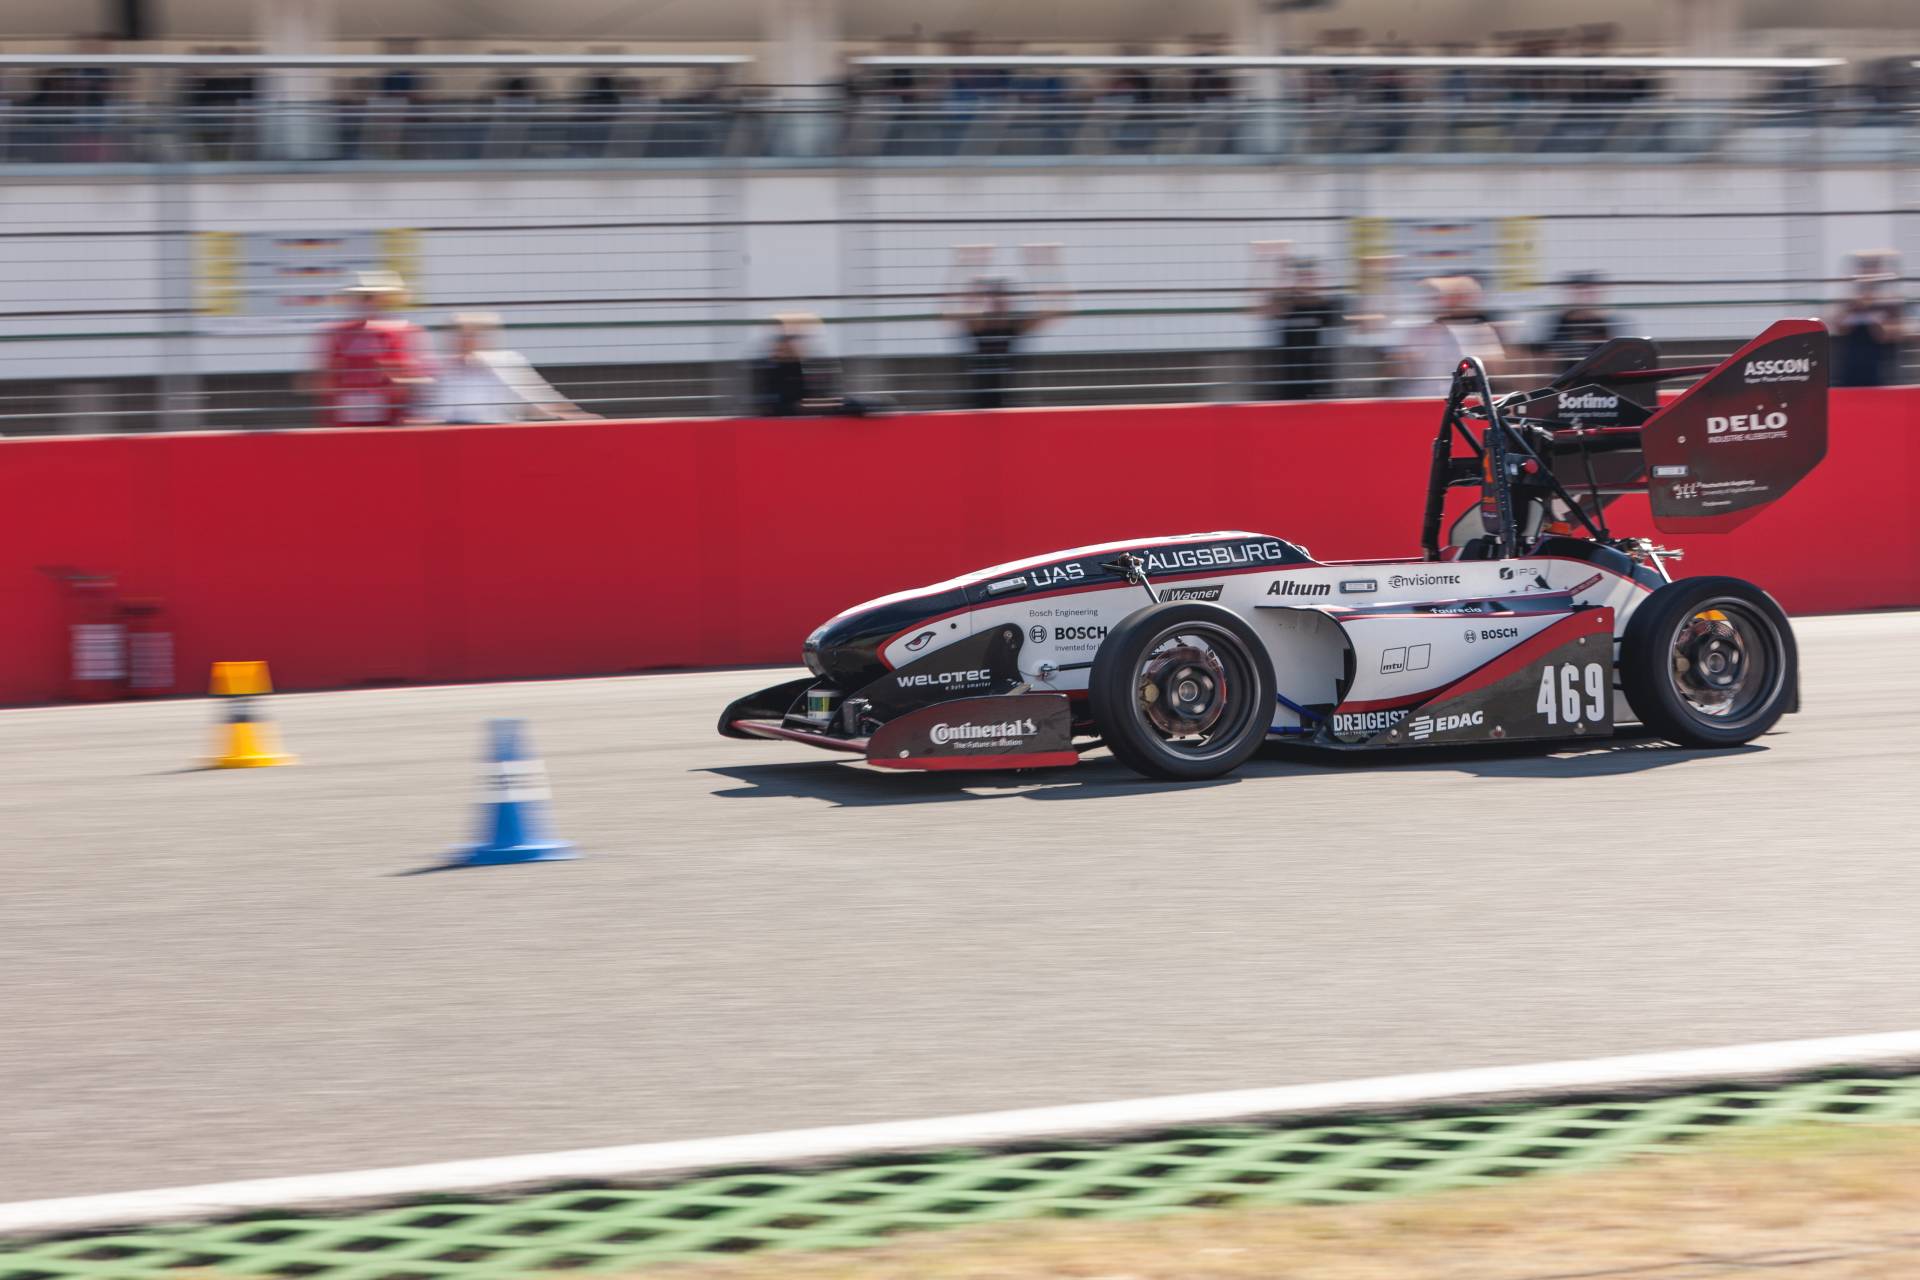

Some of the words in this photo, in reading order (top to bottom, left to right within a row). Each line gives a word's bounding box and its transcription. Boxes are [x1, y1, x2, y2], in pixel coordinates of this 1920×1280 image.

[1744, 358, 1809, 376] ASSCON
[1558, 392, 1619, 409] Sortimo
[1706, 412, 1788, 434] DELO
[1030, 562, 1085, 587] UAS
[1147, 541, 1282, 570] AUGSBURG
[1514, 567, 1538, 576] IPG
[1267, 580, 1331, 596] Altium
[1389, 573, 1461, 589] envisionTEC
[1171, 588, 1219, 601] Wagner
[1029, 609, 1053, 617] Bosch
[1055, 608, 1099, 618] Engineering
[1054, 626, 1108, 640] BOSCH
[1481, 628, 1518, 640] BOSCH
[1086, 643, 1097, 651] for
[1383, 662, 1403, 671] mtu
[1536, 662, 1605, 725] 469
[1436, 711, 1484, 732] EDAG
[930, 719, 1022, 744] Continental
